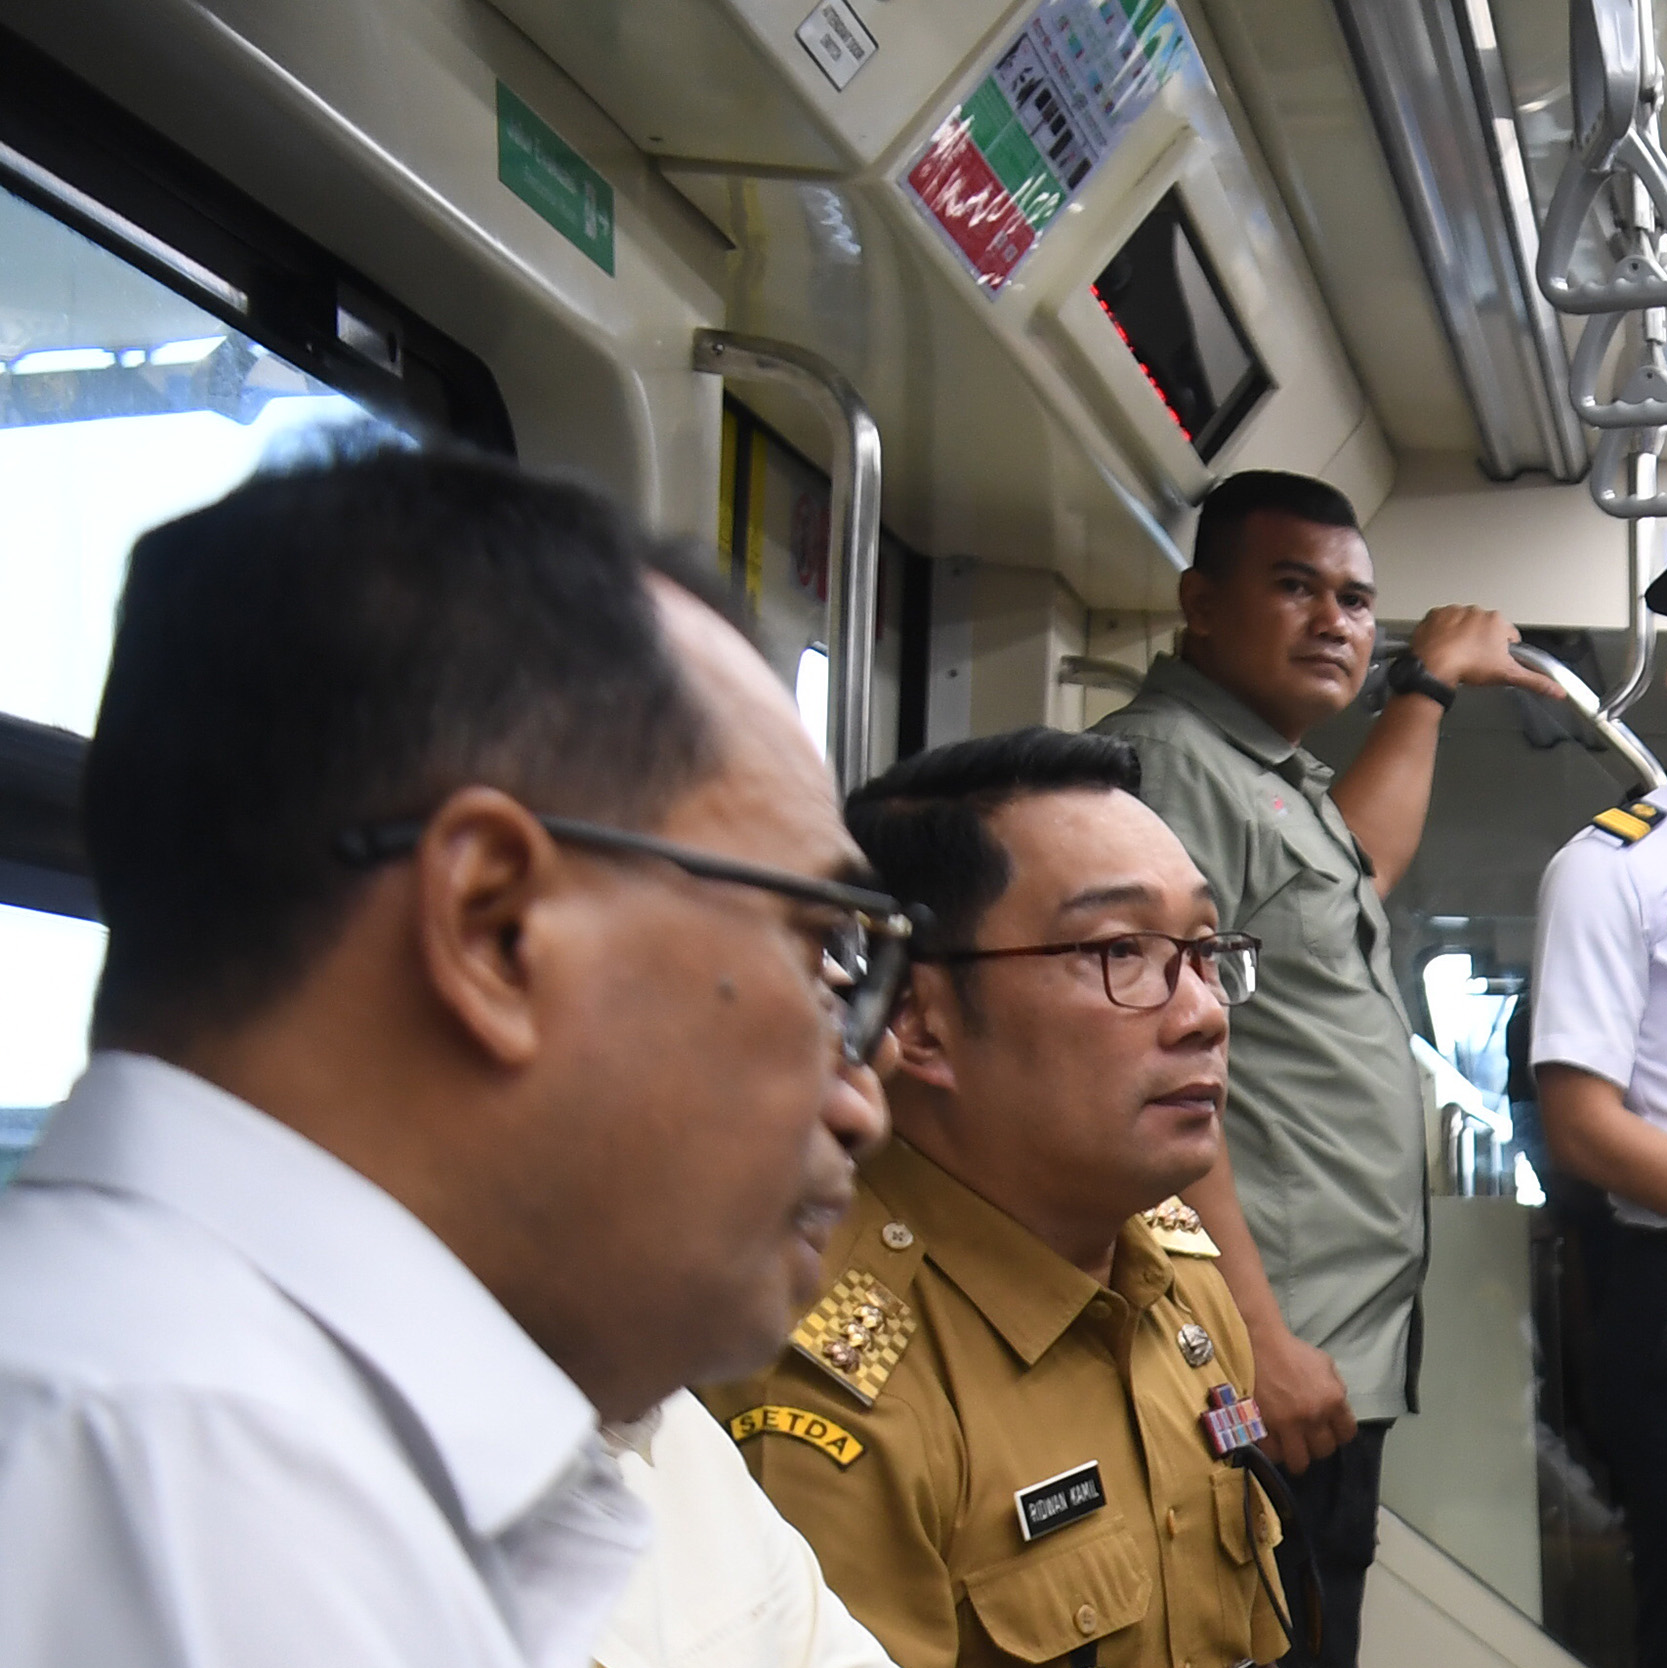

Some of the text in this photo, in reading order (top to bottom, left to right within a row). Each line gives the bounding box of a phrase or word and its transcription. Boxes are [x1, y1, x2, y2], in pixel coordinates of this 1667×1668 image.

[739, 1409, 849, 1456] SETDA
[1028, 1479, 1100, 1522] RIDWAN KAMIL
